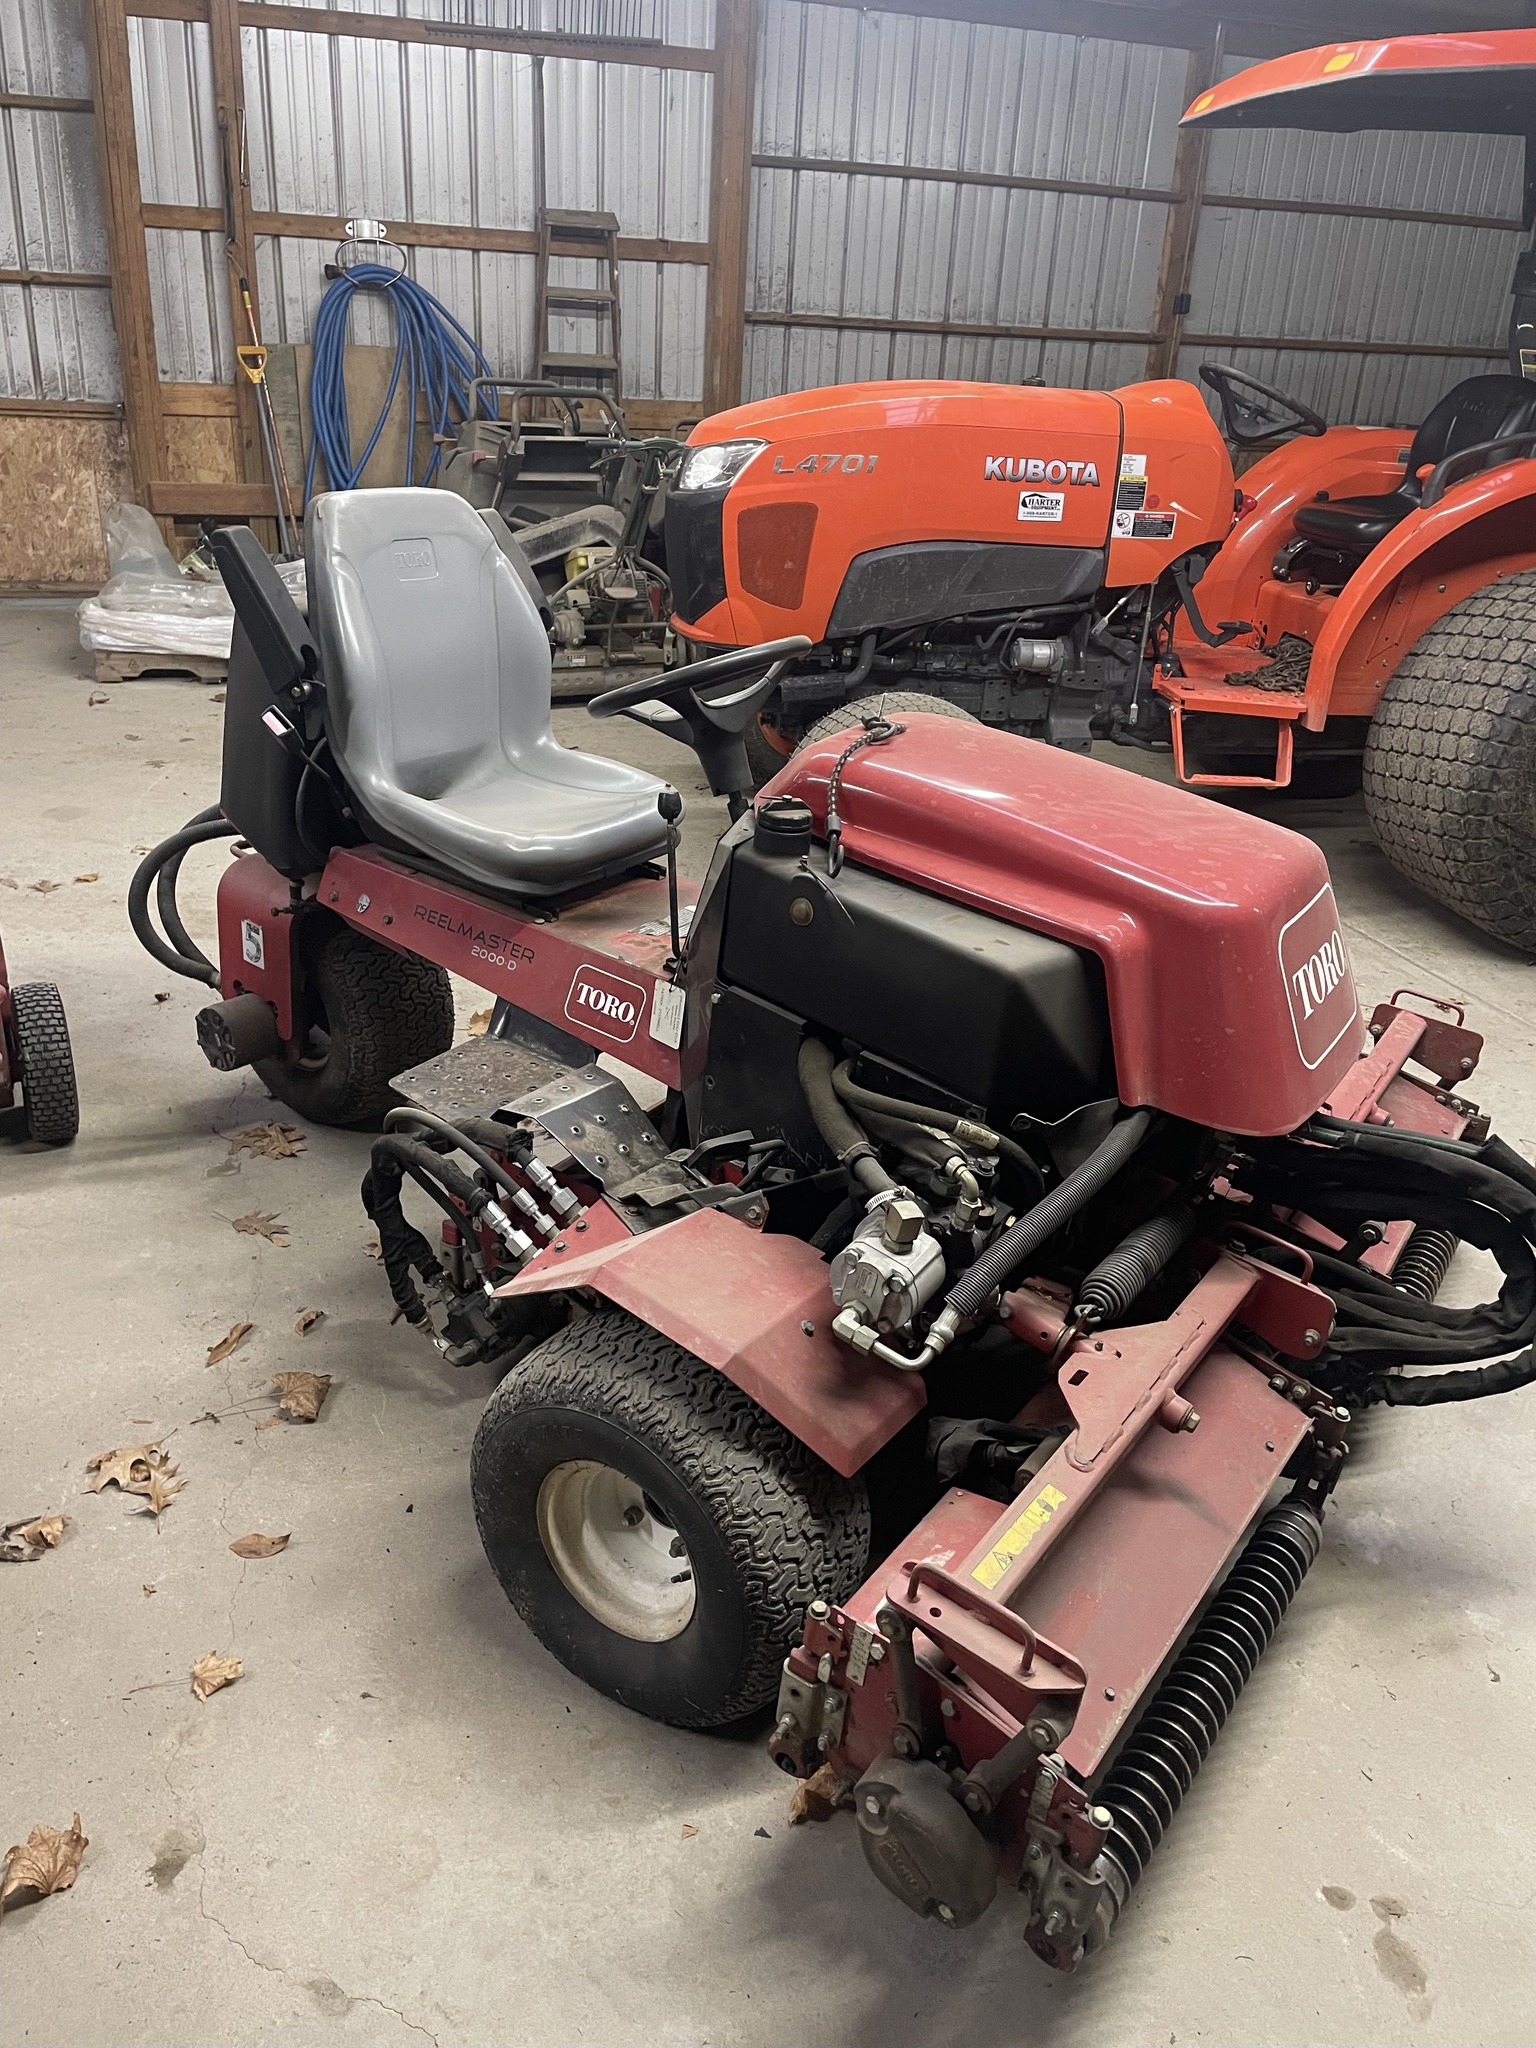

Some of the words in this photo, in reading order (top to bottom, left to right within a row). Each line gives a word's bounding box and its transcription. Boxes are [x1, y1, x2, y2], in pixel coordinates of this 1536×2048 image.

[773, 454, 879, 475] L4701
[984, 455, 1101, 487] KUBOTA
[1028, 498, 1061, 506] HARTER
[394, 551, 431, 568] TORO
[413, 904, 536, 964] REELMASTER
[1292, 929, 1345, 1020] TORO
[576, 982, 635, 1024] TORO
